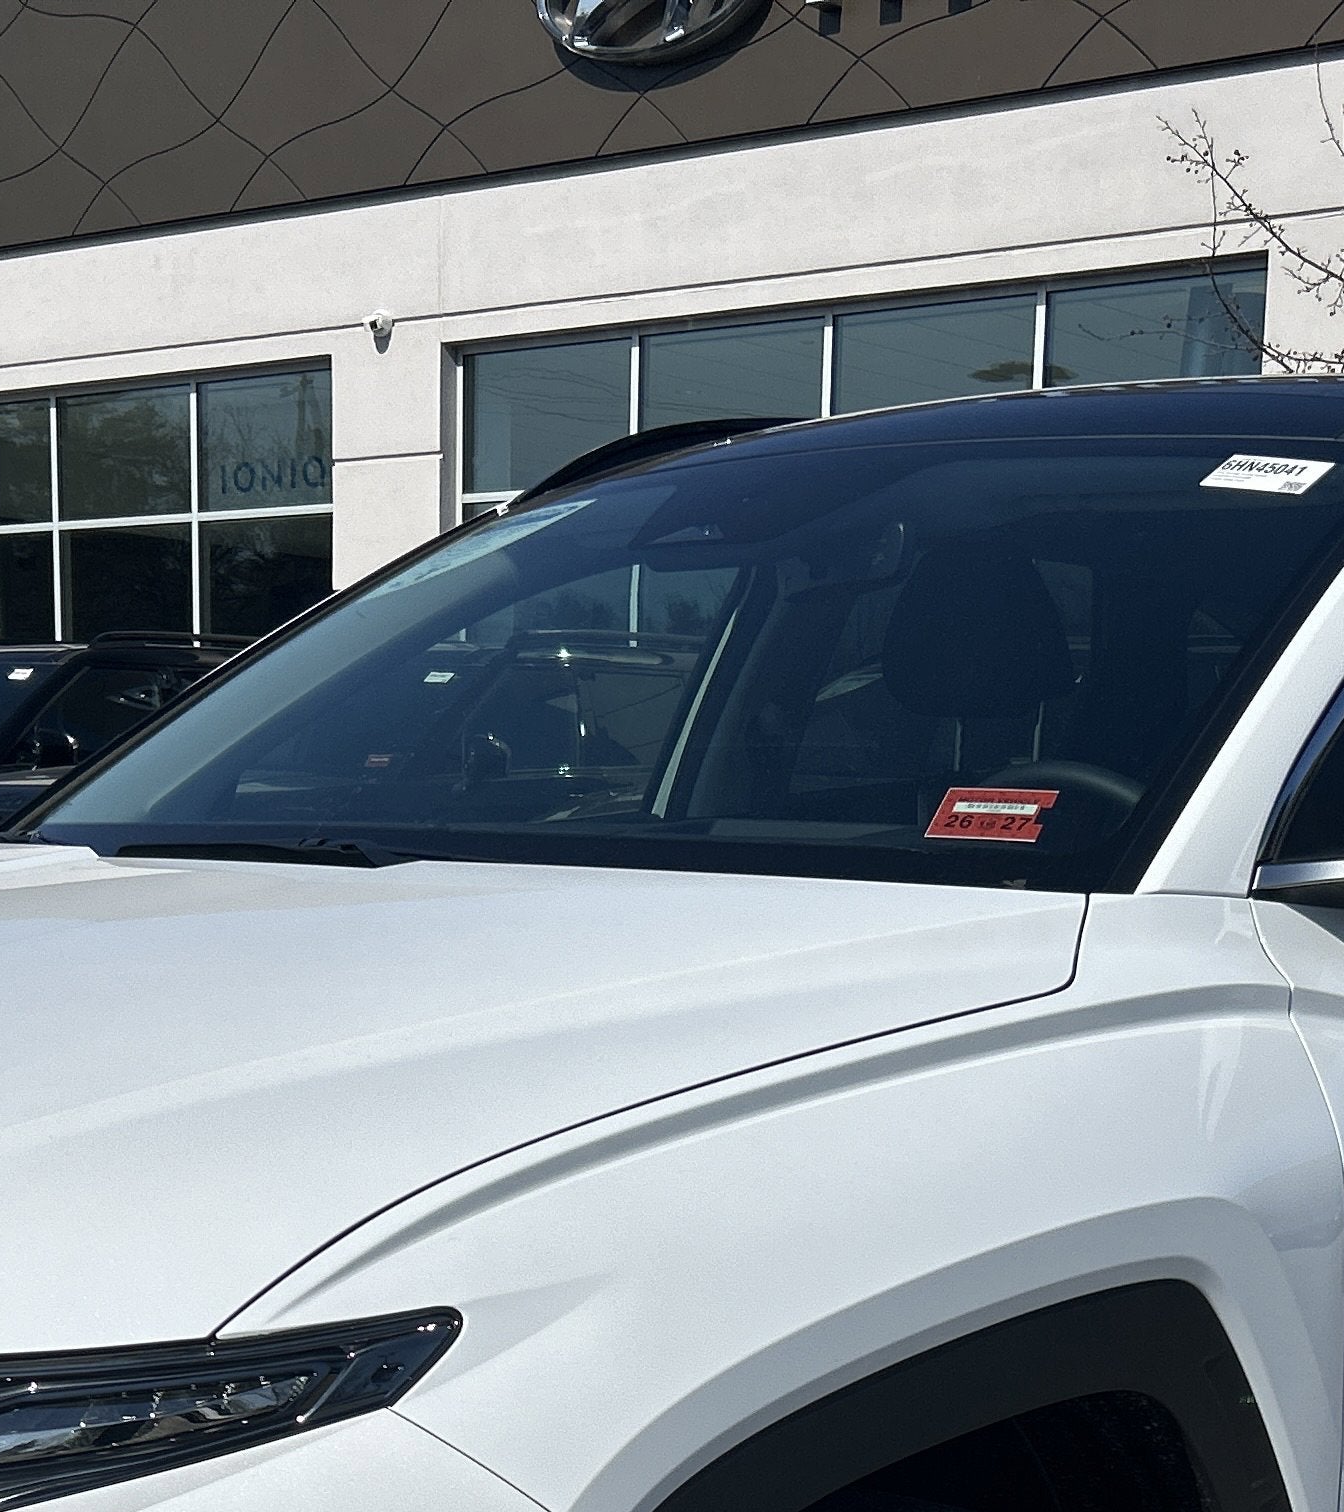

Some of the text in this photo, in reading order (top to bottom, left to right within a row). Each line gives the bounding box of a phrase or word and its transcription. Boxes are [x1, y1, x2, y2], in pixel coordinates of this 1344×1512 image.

[220, 455, 326, 494] IONIQ
[944, 814, 1033, 831] 26 27
